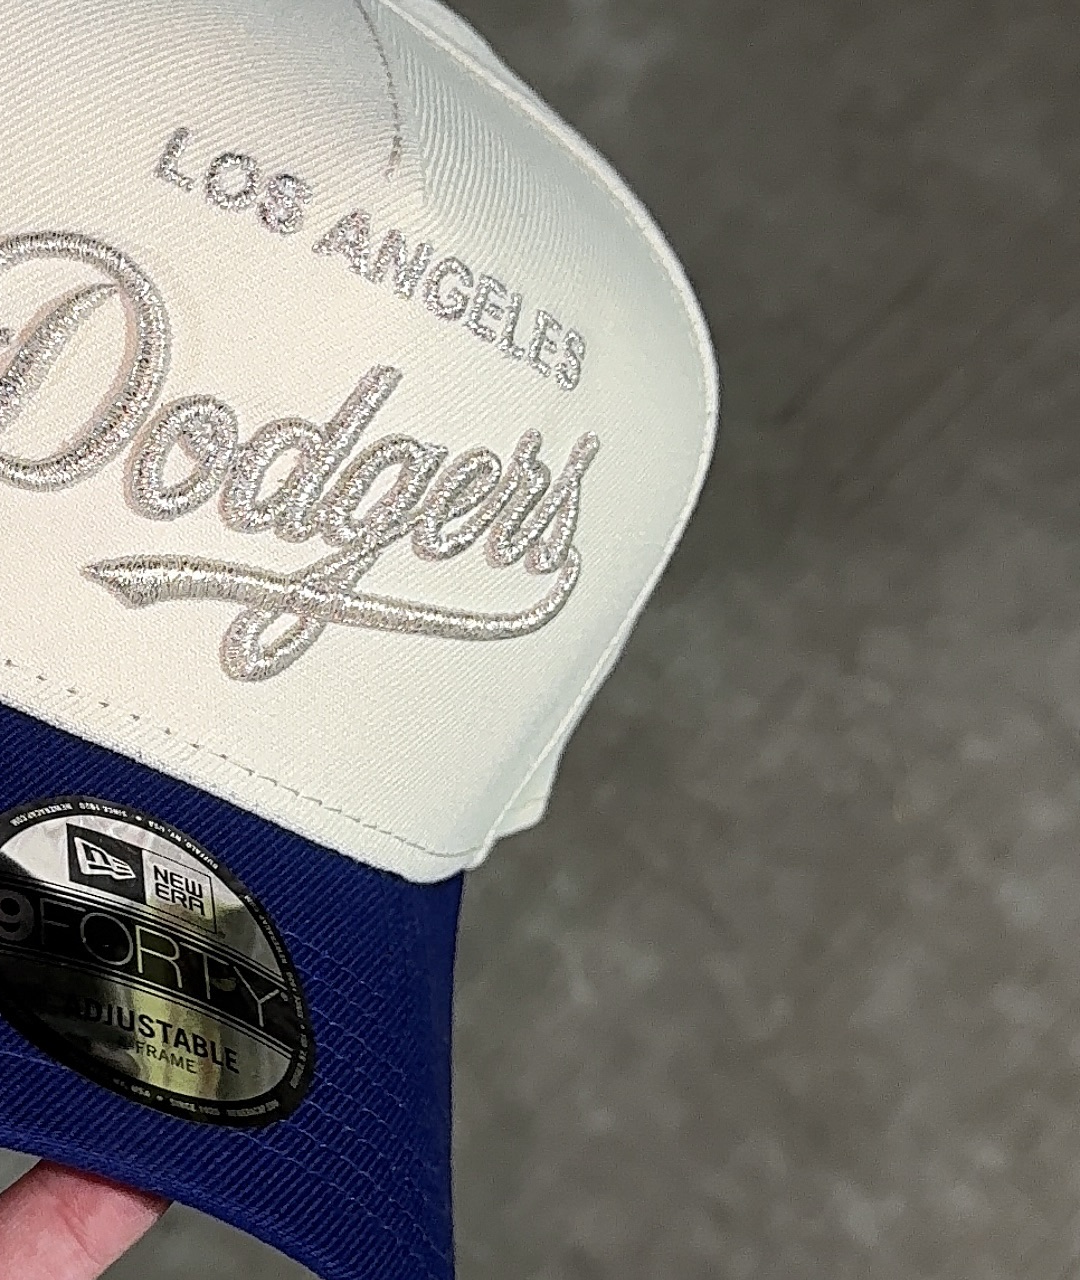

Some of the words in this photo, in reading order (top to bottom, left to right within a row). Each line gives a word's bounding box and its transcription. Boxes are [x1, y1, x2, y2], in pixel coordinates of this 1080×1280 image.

[156, 126, 313, 235] LOS
[312, 208, 587, 391] ANGELES
[153, 864, 204, 899] NEW
[154, 883, 206, 917] ERA
